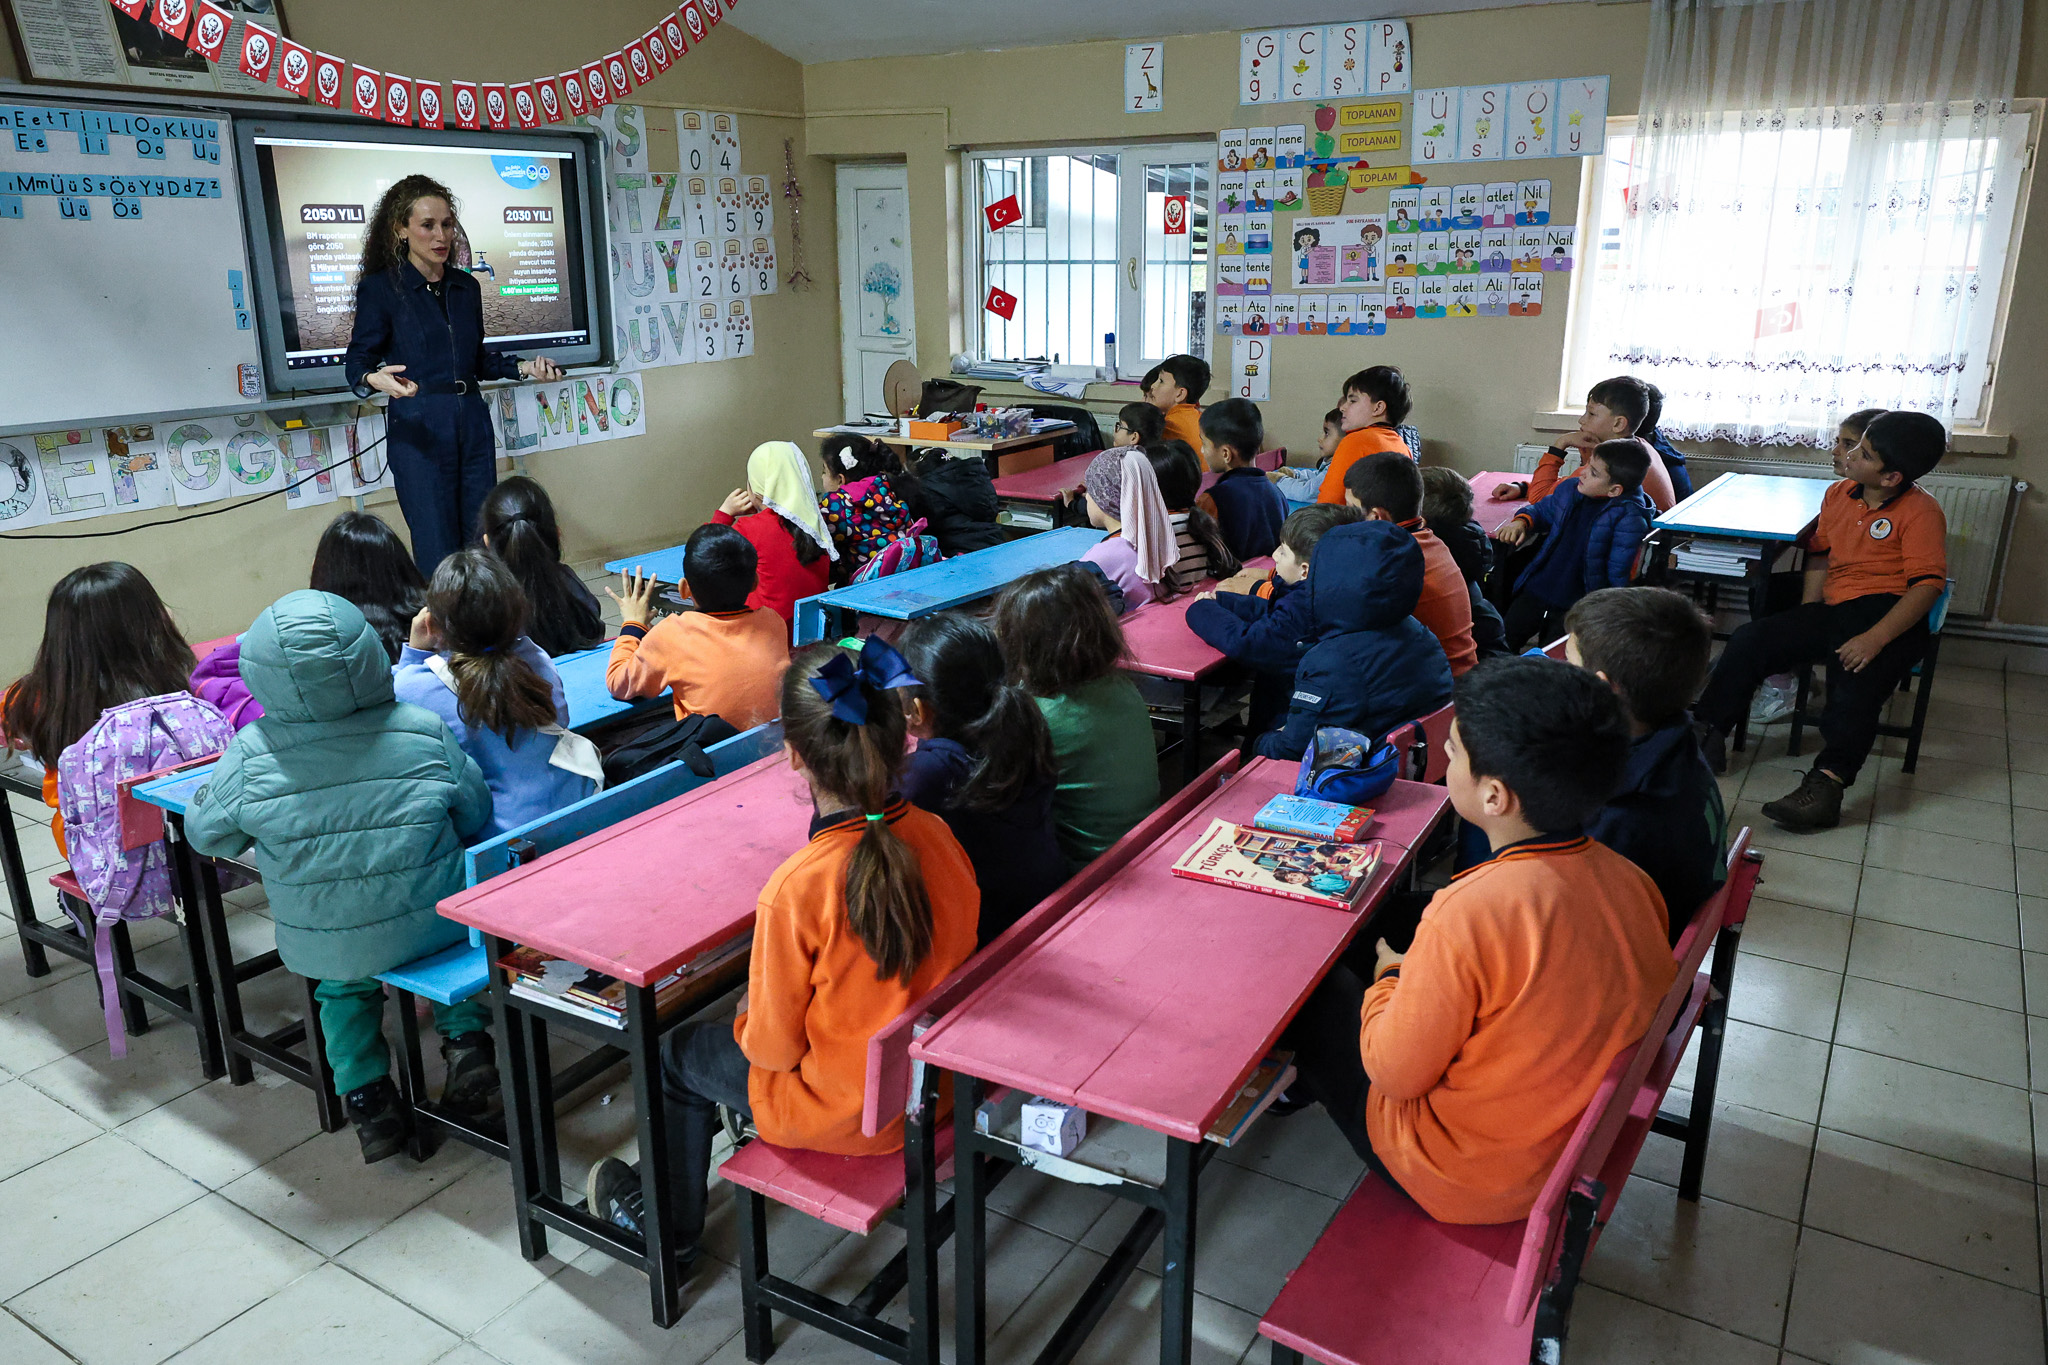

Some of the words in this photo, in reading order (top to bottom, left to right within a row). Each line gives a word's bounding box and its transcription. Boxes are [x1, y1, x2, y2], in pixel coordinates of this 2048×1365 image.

[116, 2, 131, 13] ATA
[158, 21, 175, 34] ATA
[1344, 28, 1355, 54] Ş
[1384, 24, 1394, 47] P
[1257, 37, 1274, 58] G
[1299, 32, 1315, 54] C
[195, 46, 211, 57] ATA
[1142, 48, 1154, 69] Z
[246, 68, 260, 78] ATA
[1334, 78, 1342, 94] ş
[1381, 72, 1390, 91] p
[285, 84, 300, 93] ATA
[1250, 80, 1259, 101] g
[1293, 83, 1302, 95] c
[1134, 96, 1142, 108] z
[1431, 92, 1447, 119] Ü
[1482, 91, 1495, 114] S
[359, 108, 373, 116] ATA
[1346, 109, 1395, 119] TOPLANAN
[18, 133, 29, 149] E
[85, 133, 89, 152] İ
[100, 139, 104, 150] i
[137, 140, 151, 154] O
[156, 146, 163, 154] o
[194, 144, 205, 158] U
[211, 152, 217, 160] u
[1347, 135, 1395, 146] TOPLANAN
[1515, 136, 1526, 154] ö
[1570, 132, 1580, 151] y
[1424, 141, 1434, 159] ü
[1473, 144, 1481, 157] s
[691, 150, 700, 170] 0
[721, 151, 731, 170] 4
[1255, 179, 1264, 188] at
[1284, 177, 1293, 186] et
[1359, 173, 1397, 182] TOPLAM
[1460, 191, 1475, 203] ele
[1487, 189, 1513, 202] atlet
[1524, 185, 1542, 199] Nil
[616, 173, 646, 232] T
[652, 174, 681, 230] Z
[1392, 198, 1416, 207] ninni
[1431, 193, 1440, 205] al
[61, 198, 74, 217] Ü
[79, 205, 87, 216] ü
[113, 198, 128, 217] Ö
[131, 204, 139, 215] ö
[303, 208, 336, 220] 2050
[338, 208, 362, 220] YILI
[506, 210, 531, 221] 2030
[533, 211, 551, 221] YILI
[699, 215, 704, 234] 1
[727, 212, 735, 232] 5
[755, 212, 763, 230] 9
[1224, 222, 1238, 231] ten
[1251, 221, 1266, 230] tan
[1429, 238, 1438, 250] el
[1449, 241, 1459, 249] el
[1465, 240, 1480, 248] ele
[1489, 237, 1506, 246] nal
[1520, 233, 1539, 245] ilan
[1548, 232, 1572, 245] Nail
[308, 243, 324, 251] göre
[1393, 242, 1412, 251] inat
[309, 253, 333, 262] yılında
[509, 250, 527, 258] yılında
[317, 264, 338, 272] Milyar
[620, 242, 655, 297] U
[655, 240, 682, 293] Y
[1221, 263, 1241, 272] tane
[1246, 262, 1269, 271] tente
[702, 276, 711, 296] 2
[732, 274, 740, 293] 6
[760, 272, 767, 290] 8
[1393, 282, 1409, 294] Ela
[1422, 281, 1441, 293] lale
[1453, 280, 1473, 292] alet
[1486, 279, 1502, 291] Ali
[1512, 277, 1540, 290] Talat
[1223, 304, 1237, 312] net
[1248, 301, 1265, 312] Ata
[1275, 303, 1294, 312] nine
[1310, 302, 1316, 311] it
[1339, 303, 1346, 311] in
[1361, 296, 1382, 311] İnan
[629, 305, 660, 362] Ü
[661, 303, 688, 356] V
[706, 337, 714, 355] 3
[735, 334, 744, 353] 7
[1250, 341, 1263, 360] D
[1241, 378, 1250, 397] d
[499, 388, 538, 450] L
[537, 388, 574, 437] M
[576, 378, 609, 435] N
[610, 378, 640, 426] O
[34, 429, 106, 514] E
[103, 426, 158, 505] F
[168, 425, 221, 490] G
[277, 429, 333, 498] H
[1200, 844, 1233, 871] TÜRKÇE
[1225, 869, 1243, 877] 2
